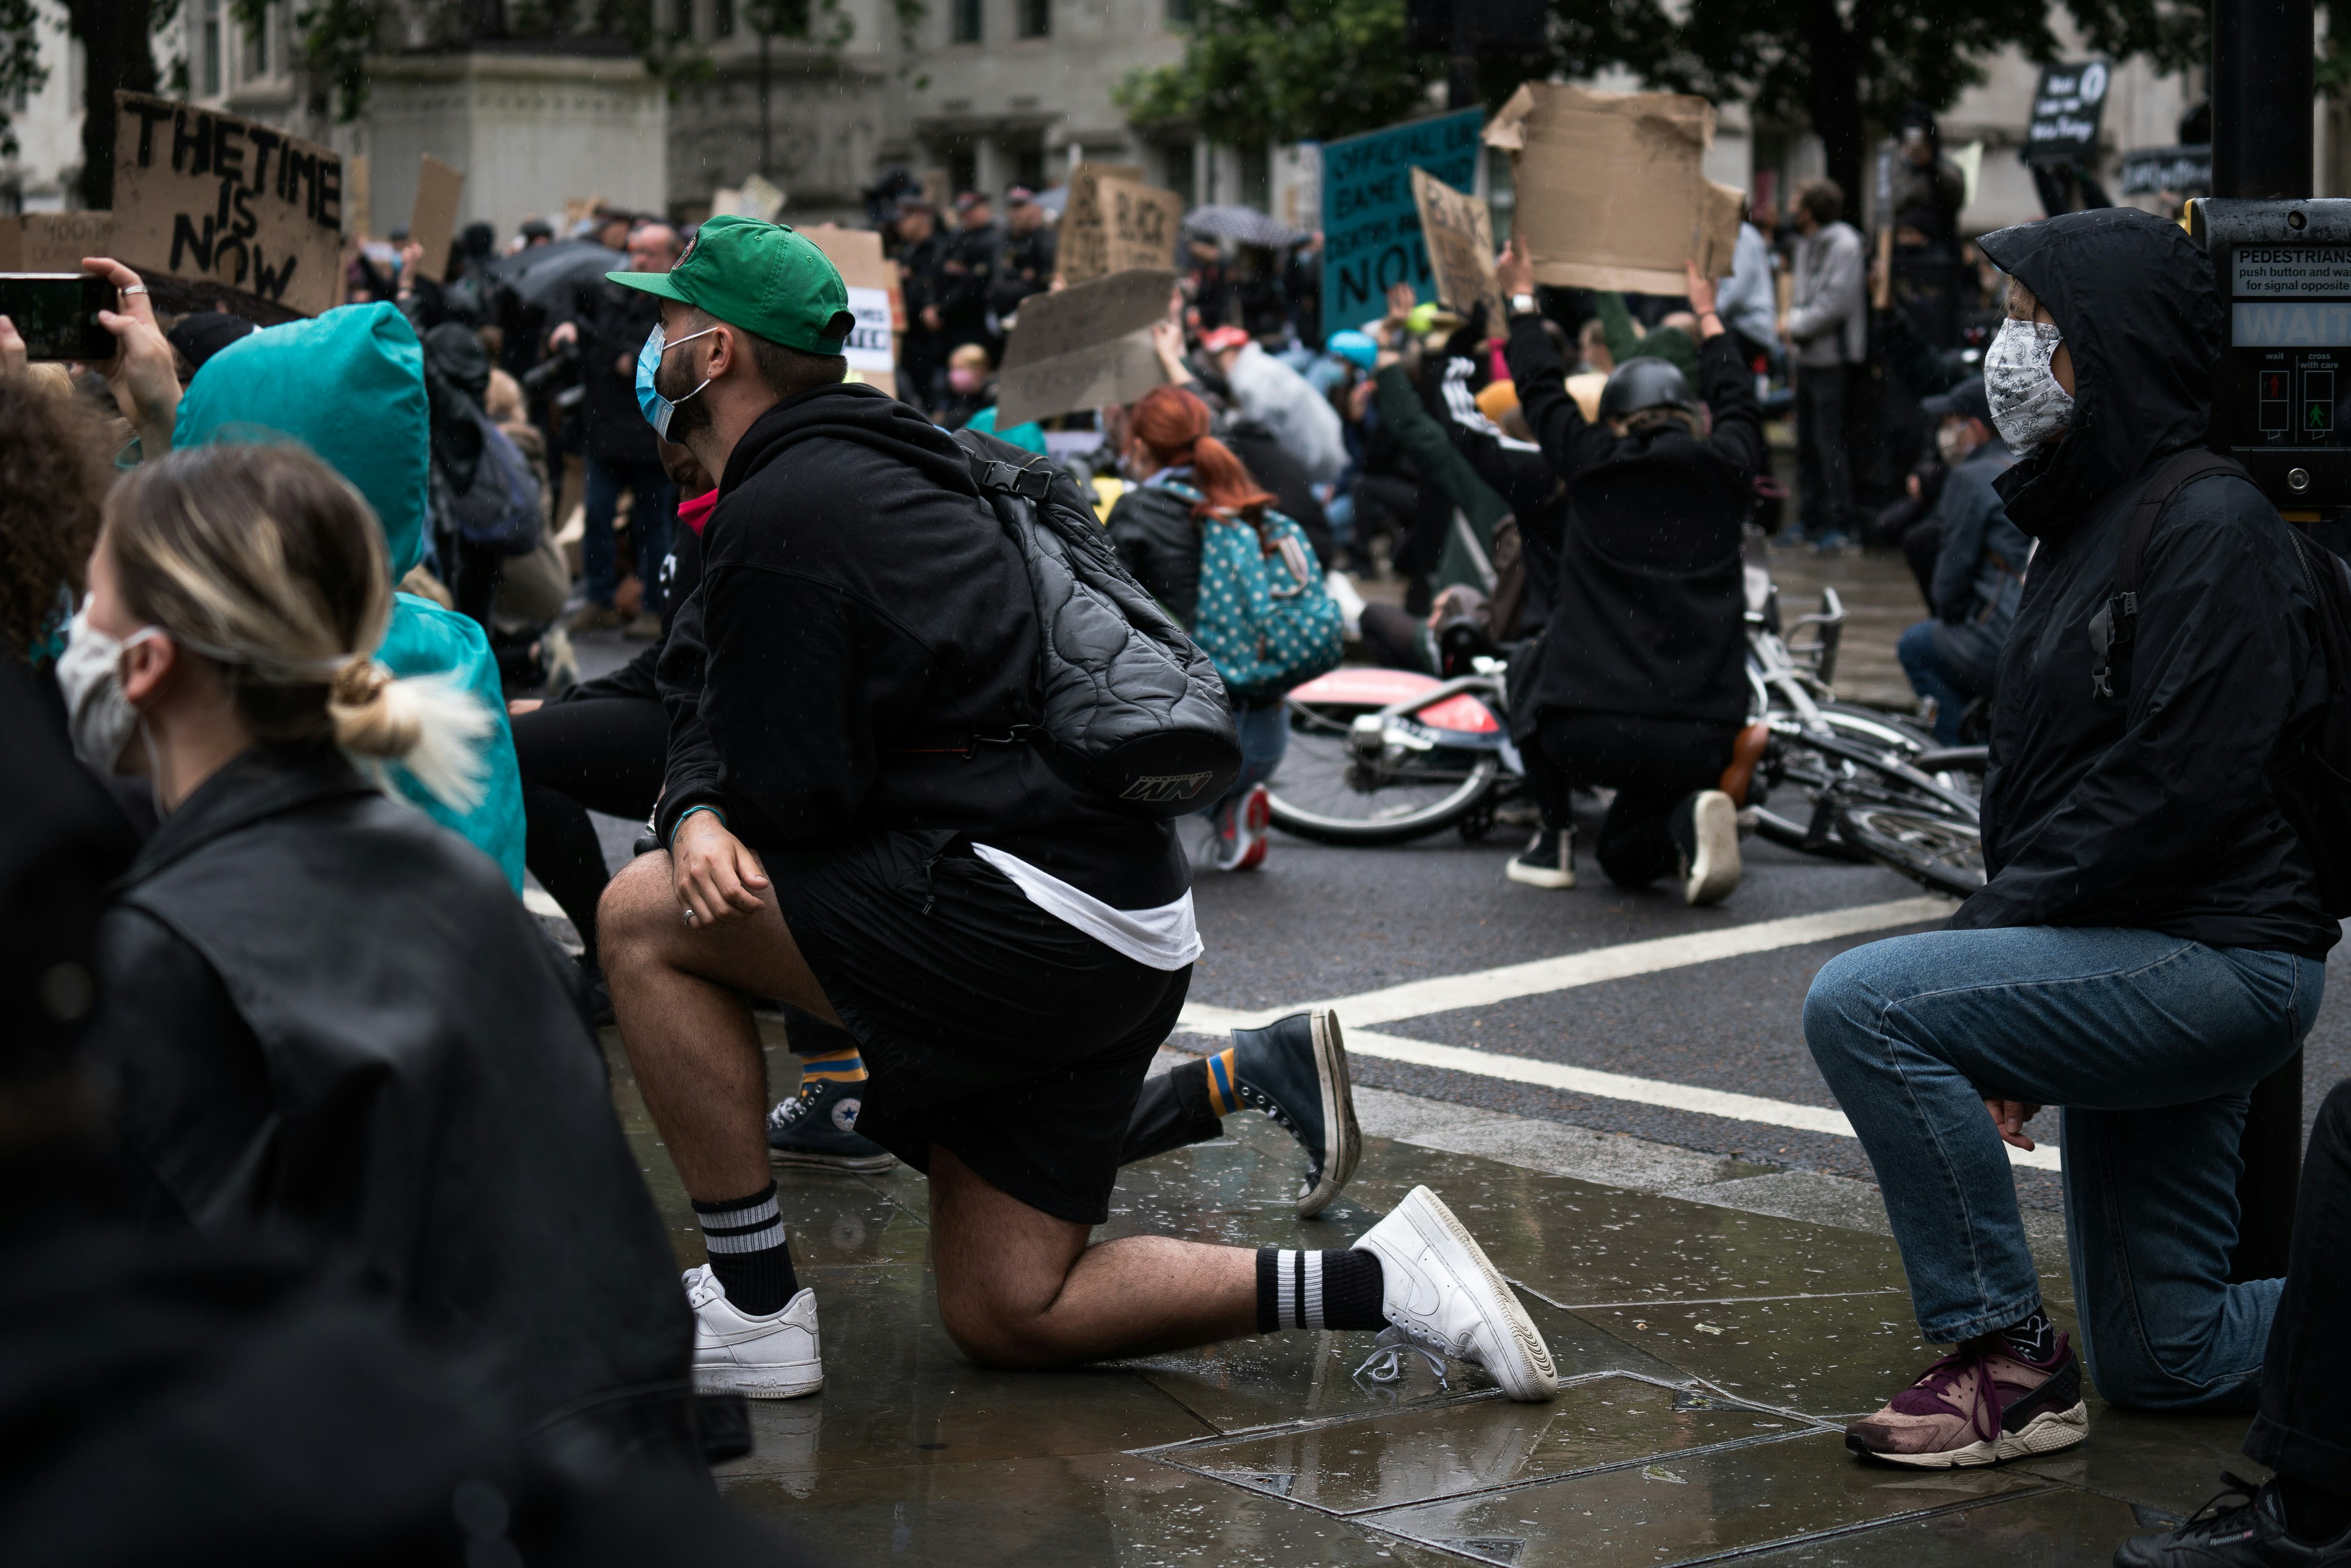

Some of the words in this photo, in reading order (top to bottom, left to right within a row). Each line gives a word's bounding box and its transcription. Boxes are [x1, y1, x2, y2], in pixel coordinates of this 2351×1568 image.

[216, 177, 257, 239] IS
[169, 213, 297, 301] NOW
[2239, 267, 2266, 279] push
[2270, 267, 2306, 277] button
[2309, 267, 2330, 277] and
[2333, 267, 2351, 277] wai
[2246, 280, 2262, 290] for
[2264, 280, 2298, 292] signal
[2301, 280, 2349, 292] opposite
[2241, 307, 2351, 343] WAIT
[836, 1100, 860, 1112] CONVERS
[2210, 1533, 2243, 1546] Reebok
